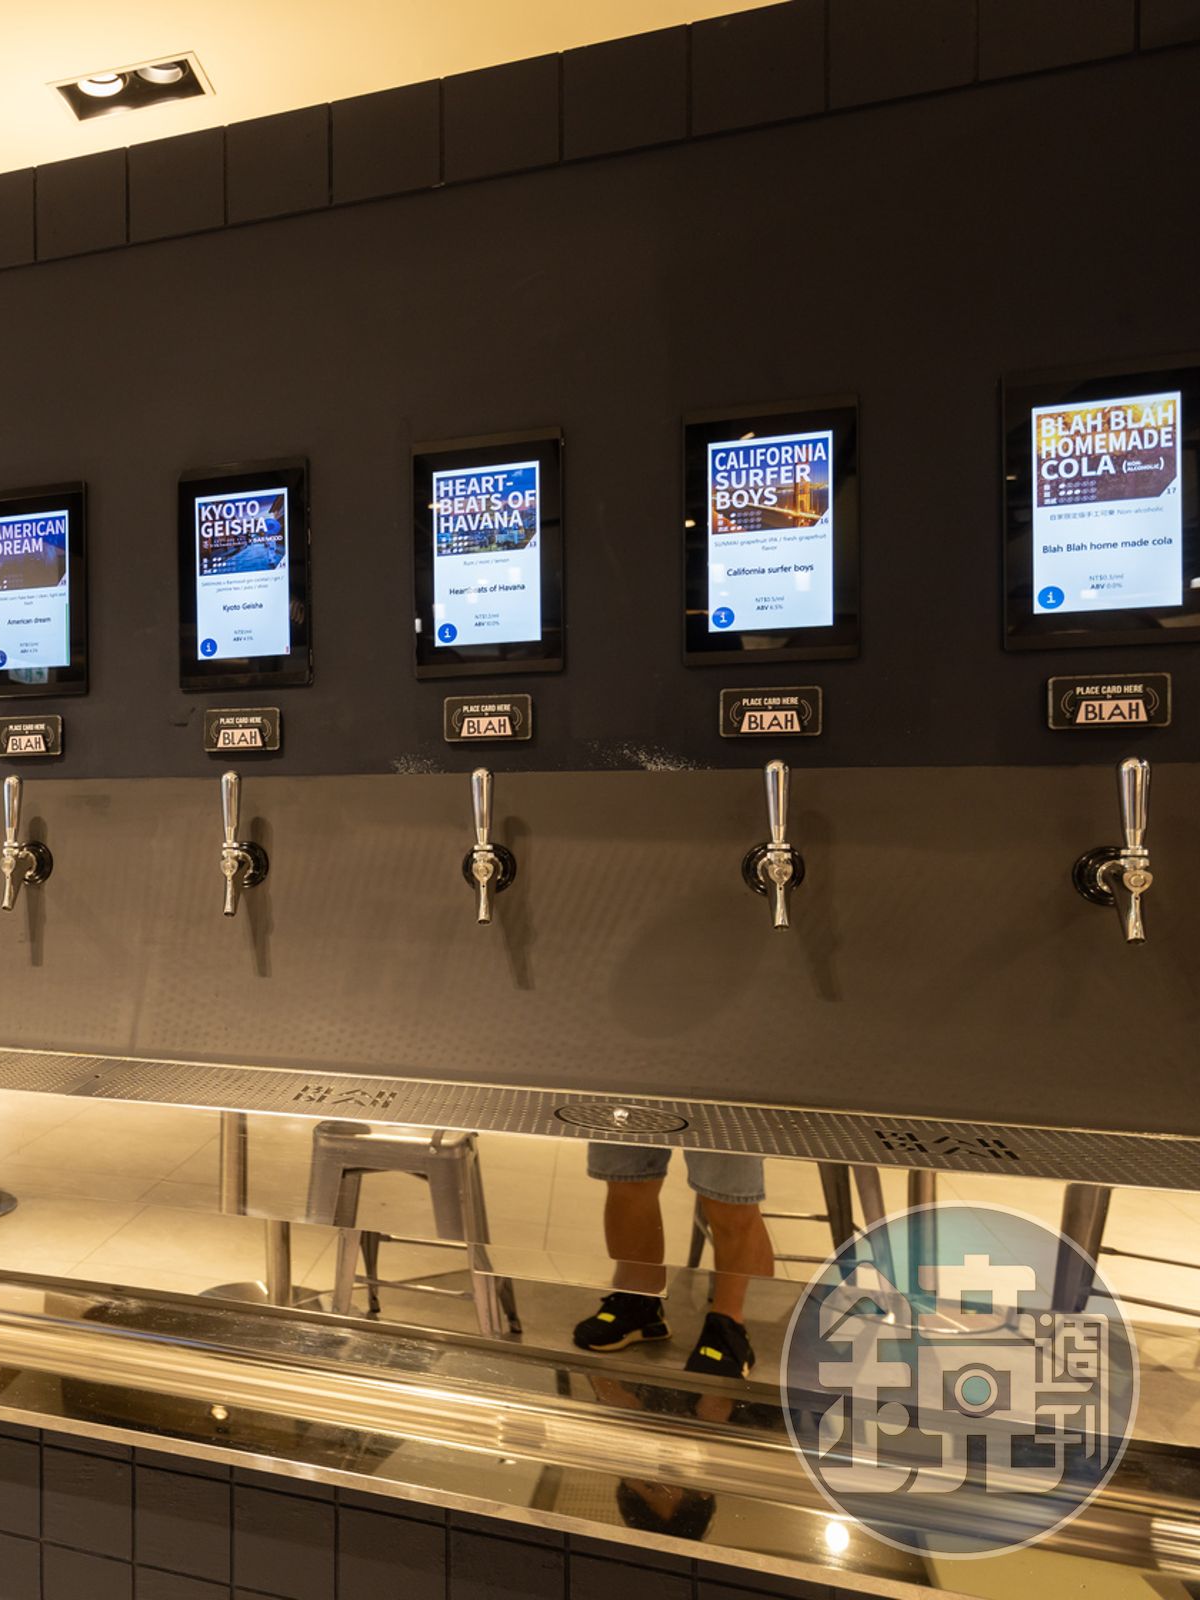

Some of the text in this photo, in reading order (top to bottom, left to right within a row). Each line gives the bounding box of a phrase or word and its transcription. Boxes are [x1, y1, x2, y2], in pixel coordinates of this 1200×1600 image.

[1041, 404, 1174, 437] BLAH BLAH
[1041, 428, 1173, 458] HOMEMADE
[715, 442, 826, 470] CALIFORNIA
[1041, 454, 1116, 480] COLA
[440, 474, 513, 497] HEART-
[716, 464, 811, 490] SURFER
[440, 490, 536, 515] BEATS OF
[716, 487, 778, 510] BOYS
[202, 500, 260, 521] KYOTO
[201, 517, 268, 538] GEISHA
[440, 510, 523, 534] HAVANA
[1042, 537, 1172, 553] Blah Blah home made cola
[727, 564, 814, 576] California surfer boys
[499, 583, 525, 591] Havana
[223, 602, 263, 612] Kyoto Geisha
[1076, 684, 1143, 695] PLACE CARD HERE
[743, 698, 762, 706] PLACE
[764, 697, 780, 705] CARD
[1085, 703, 1139, 720] BLAH
[467, 719, 506, 734] BLAH
[748, 714, 794, 730] BLAH
[12, 737, 40, 750] BLAH
[223, 731, 257, 745] BLAH
